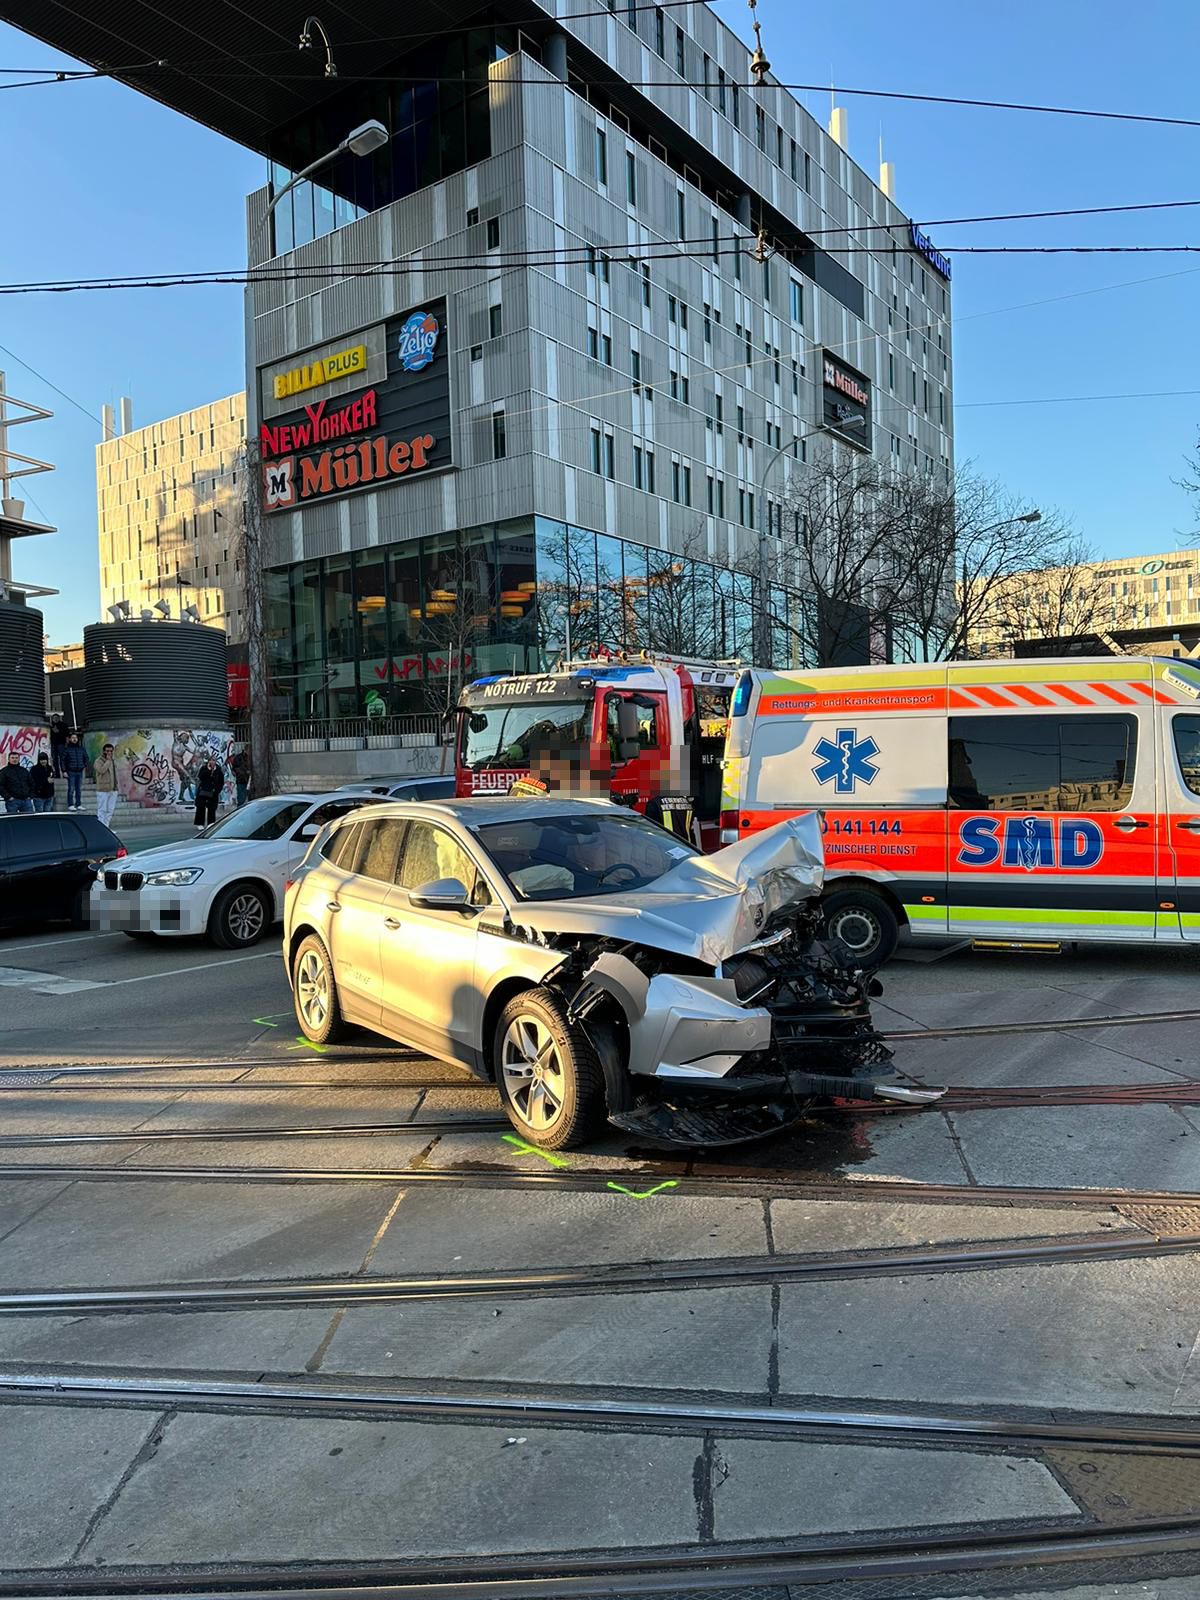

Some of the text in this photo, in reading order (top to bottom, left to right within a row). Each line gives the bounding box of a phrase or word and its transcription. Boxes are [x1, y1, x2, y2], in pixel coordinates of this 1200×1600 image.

[274, 351, 359, 399] BILLA PLUS
[835, 370, 869, 406] Müller
[270, 434, 434, 497] M Müller
[483, 680, 557, 698] NOTRUF 122
[771, 694, 935, 711] Rettungs- und Krankentransport
[702, 754, 714, 764] HLF
[833, 819, 861, 835] 141
[869, 820, 902, 835] 144
[880, 845, 917, 855] DIENST
[957, 815, 1104, 871] SMD
